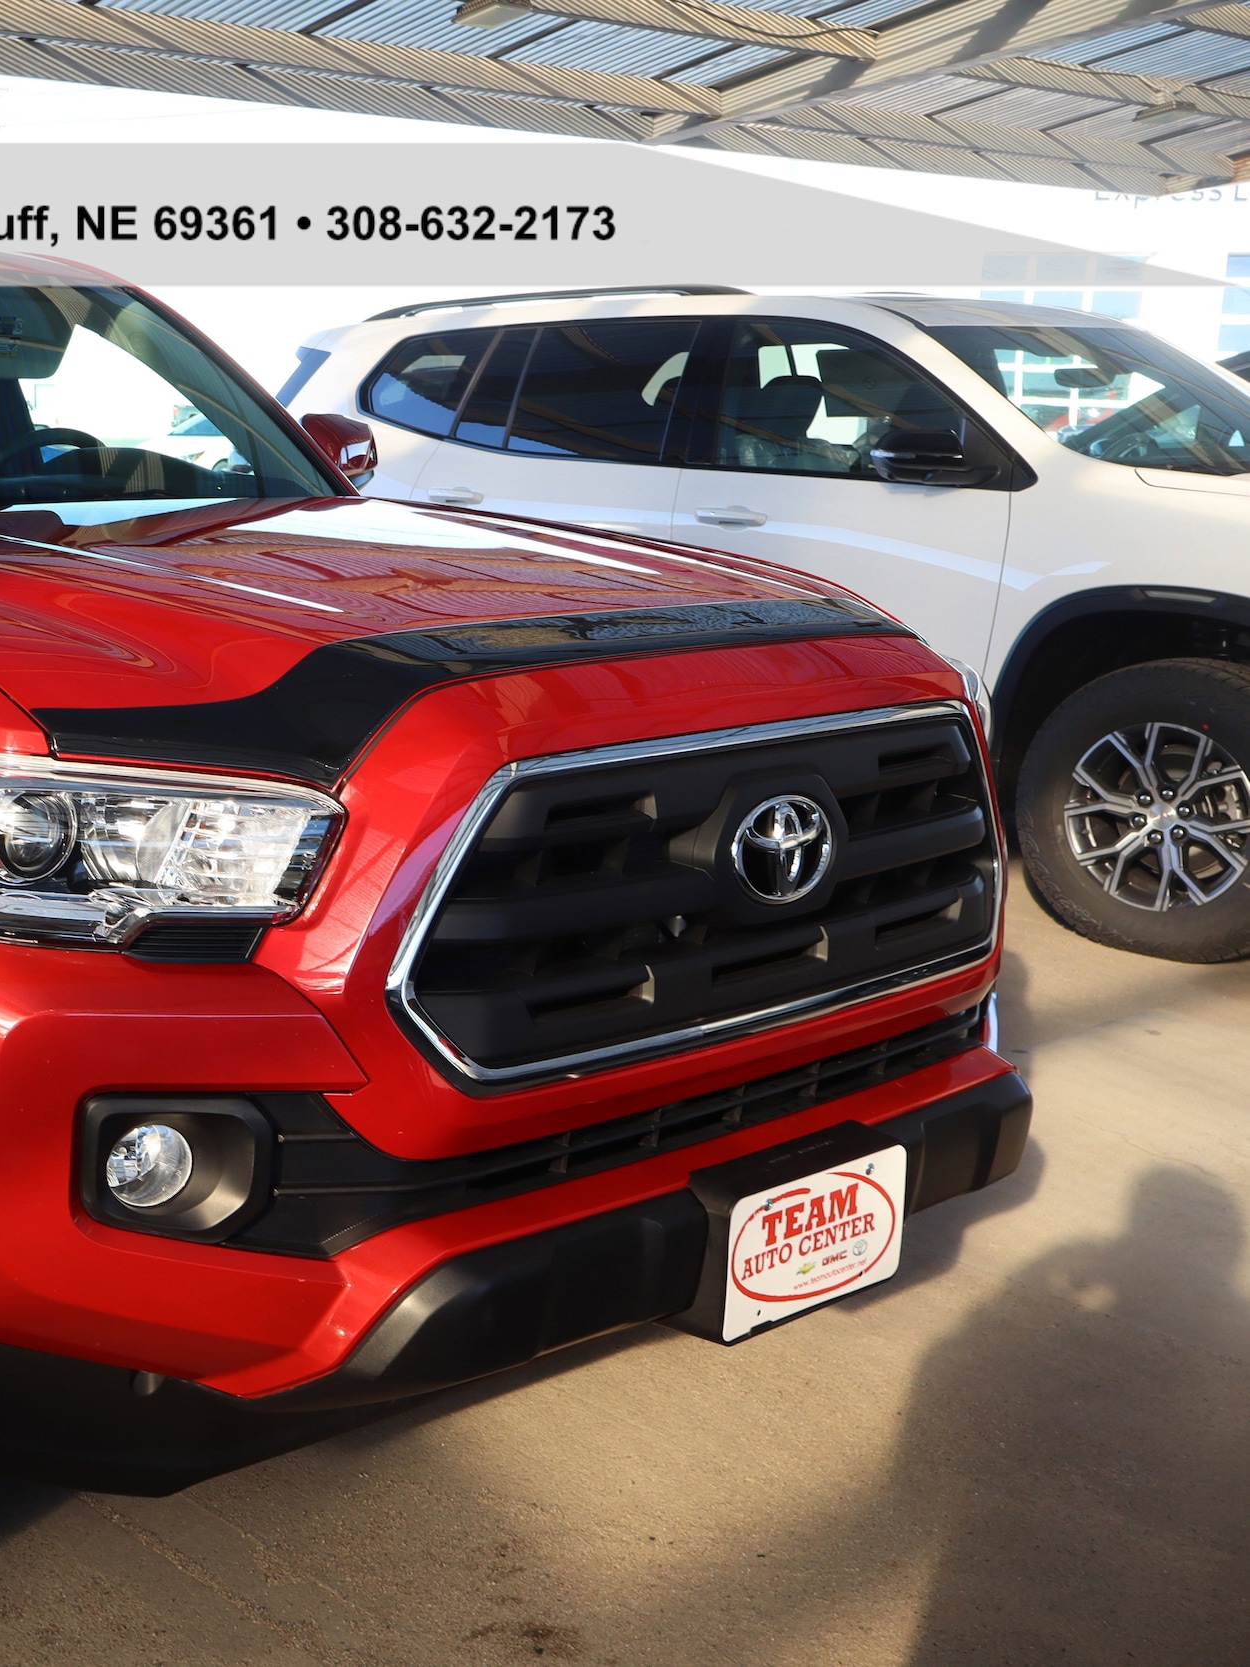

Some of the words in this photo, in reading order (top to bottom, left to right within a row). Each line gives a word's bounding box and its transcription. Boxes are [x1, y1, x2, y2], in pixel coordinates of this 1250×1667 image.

[1095, 188, 1222, 209] xpess
[762, 1183, 859, 1246] TEAM
[741, 1243, 793, 1281] AUTO
[799, 1212, 876, 1256] CENTER
[821, 1249, 848, 1267] GMC
